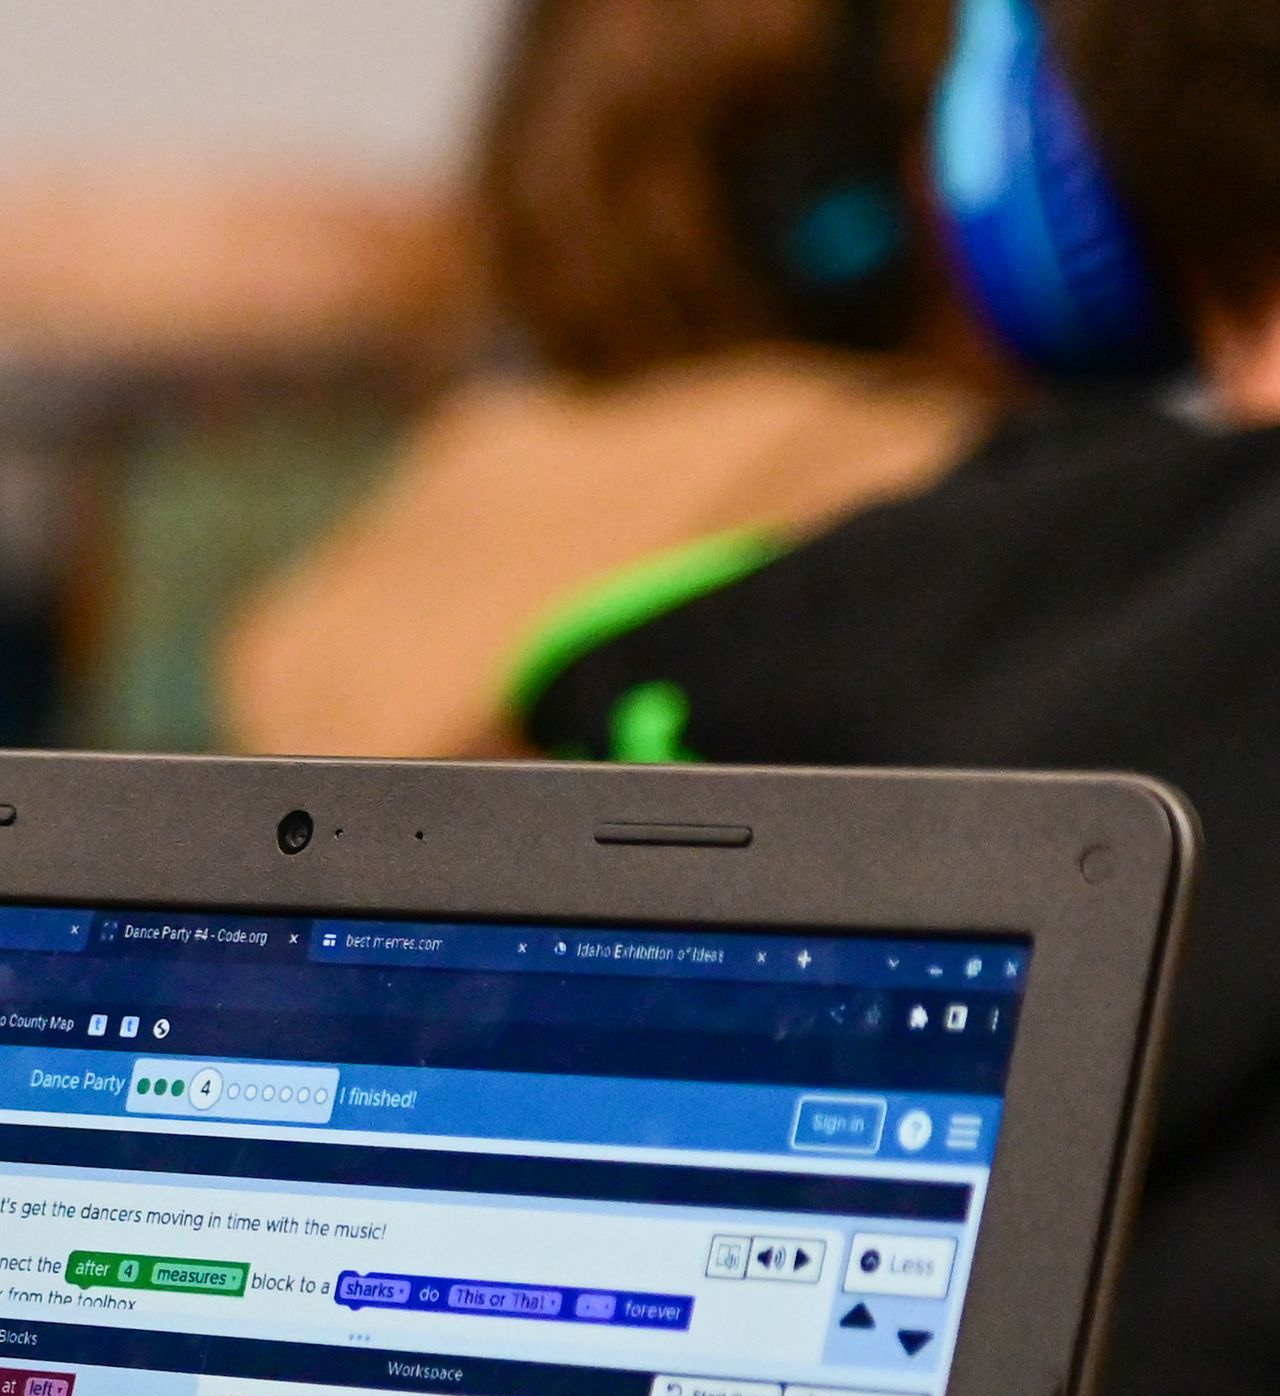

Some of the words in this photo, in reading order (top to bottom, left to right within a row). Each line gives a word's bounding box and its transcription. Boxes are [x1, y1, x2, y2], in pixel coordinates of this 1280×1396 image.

[124, 924, 160, 941] Dance
[161, 926, 191, 944] Party
[194, 929, 209, 943] #4
[217, 928, 268, 947] Code.org
[613, 943, 674, 961] Exhibition
[9, 1013, 48, 1033] County
[49, 1016, 75, 1032] Map
[30, 1068, 80, 1090] Dance
[83, 1071, 126, 1096] Party
[200, 1079, 212, 1097] 4
[348, 1085, 418, 1110] finished!
[812, 1113, 846, 1136] Sign
[20, 1199, 48, 1221] get
[52, 1200, 77, 1219] the
[80, 1201, 142, 1223] dancers
[145, 1208, 204, 1233] moving
[207, 1211, 223, 1229] in
[227, 1212, 262, 1232] time
[265, 1214, 300, 1235] with
[304, 1217, 330, 1237] the
[334, 1219, 386, 1242] music!
[890, 1255, 935, 1277] Less
[36, 1254, 62, 1275] the
[75, 1258, 109, 1278] after
[123, 1263, 133, 1279] 4
[156, 1267, 228, 1287] measures
[252, 1272, 294, 1294] block
[300, 1276, 317, 1294] to
[319, 1280, 331, 1295] a
[346, 1280, 396, 1299] sharks
[419, 1285, 440, 1303] do
[455, 1288, 486, 1308] This
[490, 1293, 508, 1310] or
[624, 1301, 682, 1321] forever
[386, 1359, 464, 1383] Workspace
[1, 1379, 17, 1395] at
